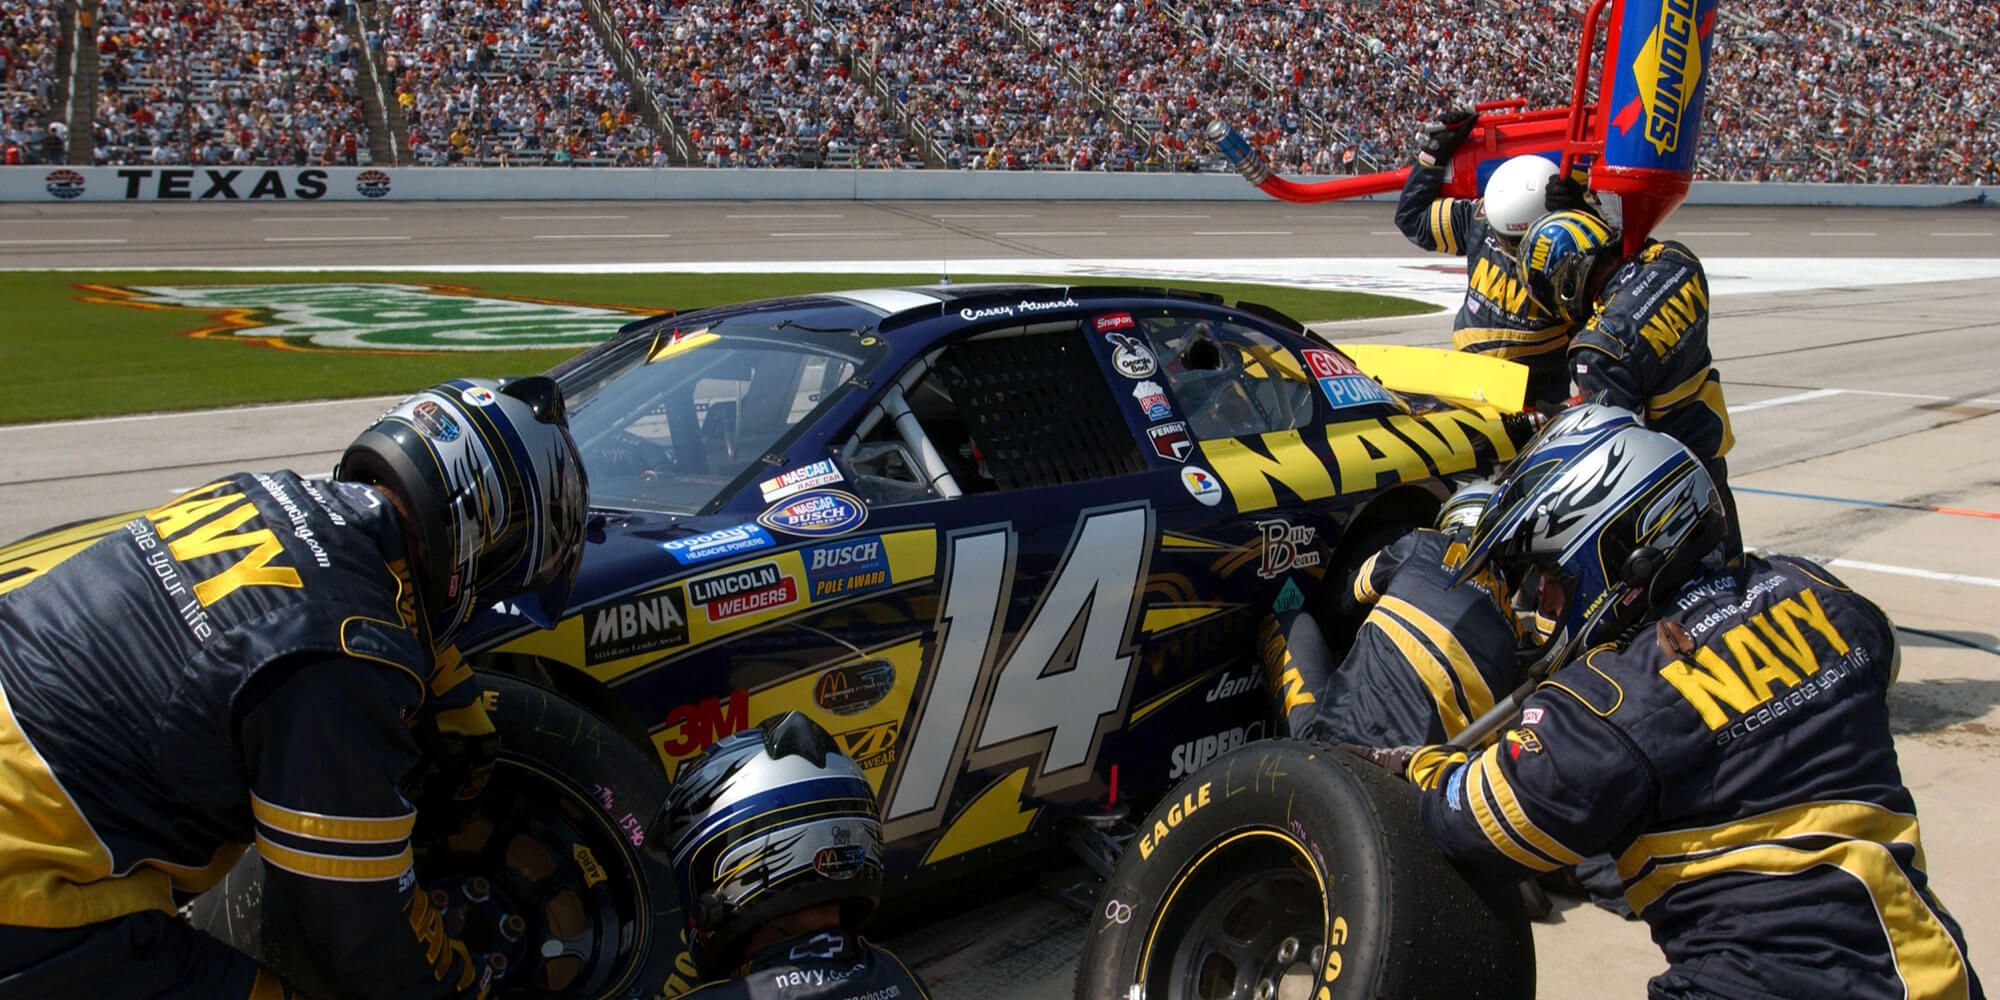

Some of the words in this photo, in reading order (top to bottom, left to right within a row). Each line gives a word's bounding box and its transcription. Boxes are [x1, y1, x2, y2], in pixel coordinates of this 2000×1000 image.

[1650, 0, 1694, 148] SUNOCO
[117, 169, 328, 200] TEXAS
[1530, 234, 1552, 272] NAVY
[1639, 272, 1708, 358] NAVY
[1131, 363, 1150, 373] Boot
[1152, 426, 1182, 439] FERRIS
[781, 460, 830, 486] NASCAR
[1200, 408, 1517, 514] NAVY
[798, 479, 820, 490] RACE
[824, 474, 840, 483] CAR
[789, 507, 845, 525] BUSCH
[792, 496, 834, 515] NASCAR
[664, 522, 760, 551] Goody's
[811, 541, 879, 571] BUSCH
[146, 551, 187, 597] your
[180, 599, 212, 643] life
[695, 568, 777, 601] LINCOLN
[815, 578, 844, 597] POLE
[846, 569, 886, 591] AWARD
[1677, 576, 1737, 610] navy.com
[718, 587, 787, 617] WELDERS
[590, 596, 685, 647] MBNA
[884, 504, 1152, 832] 14
[1659, 588, 1850, 731] NAVY
[1717, 682, 1819, 747] accelerate
[1816, 660, 1850, 691] your
[664, 689, 749, 757] 3M
[1138, 781, 1212, 862] EAGLE
